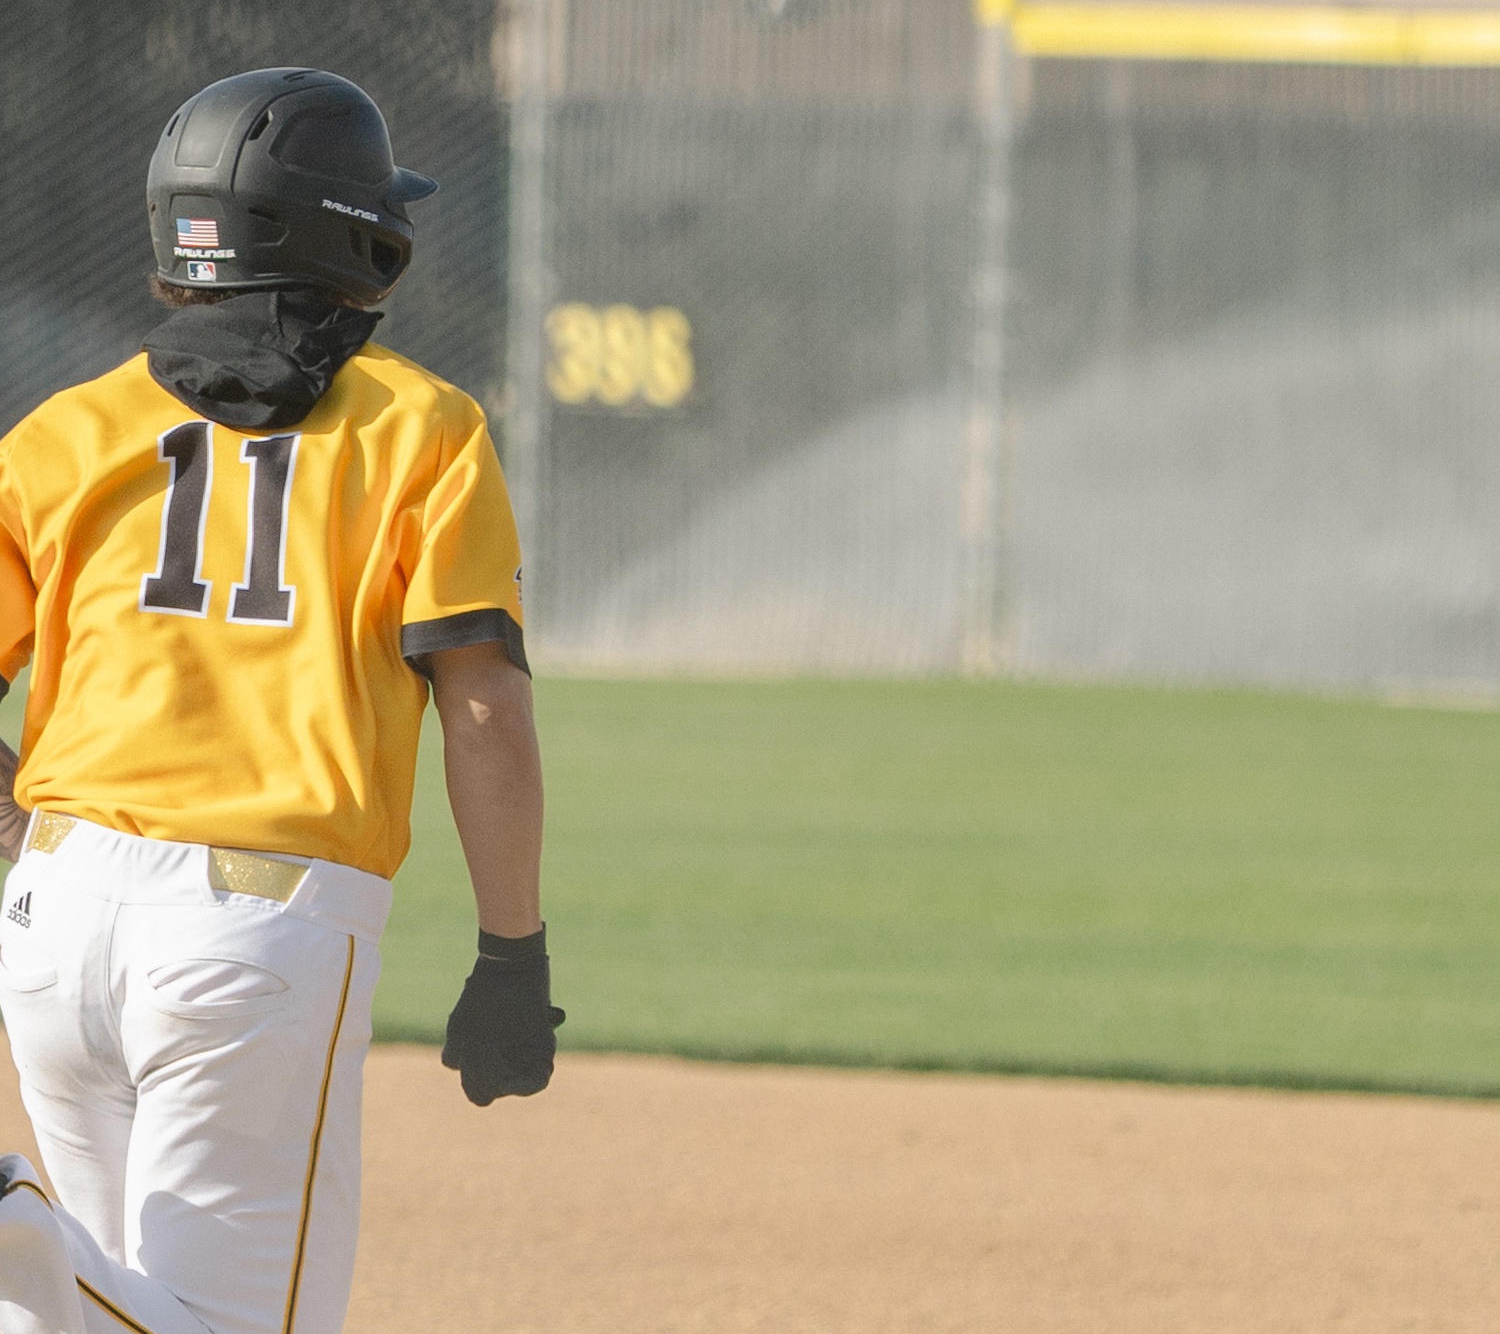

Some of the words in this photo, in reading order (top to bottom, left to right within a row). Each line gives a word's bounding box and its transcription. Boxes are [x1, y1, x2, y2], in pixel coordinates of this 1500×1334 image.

[321, 198, 380, 223] RAWLINGS
[173, 246, 237, 259] RAWLINGS
[138, 419, 303, 628] 11
